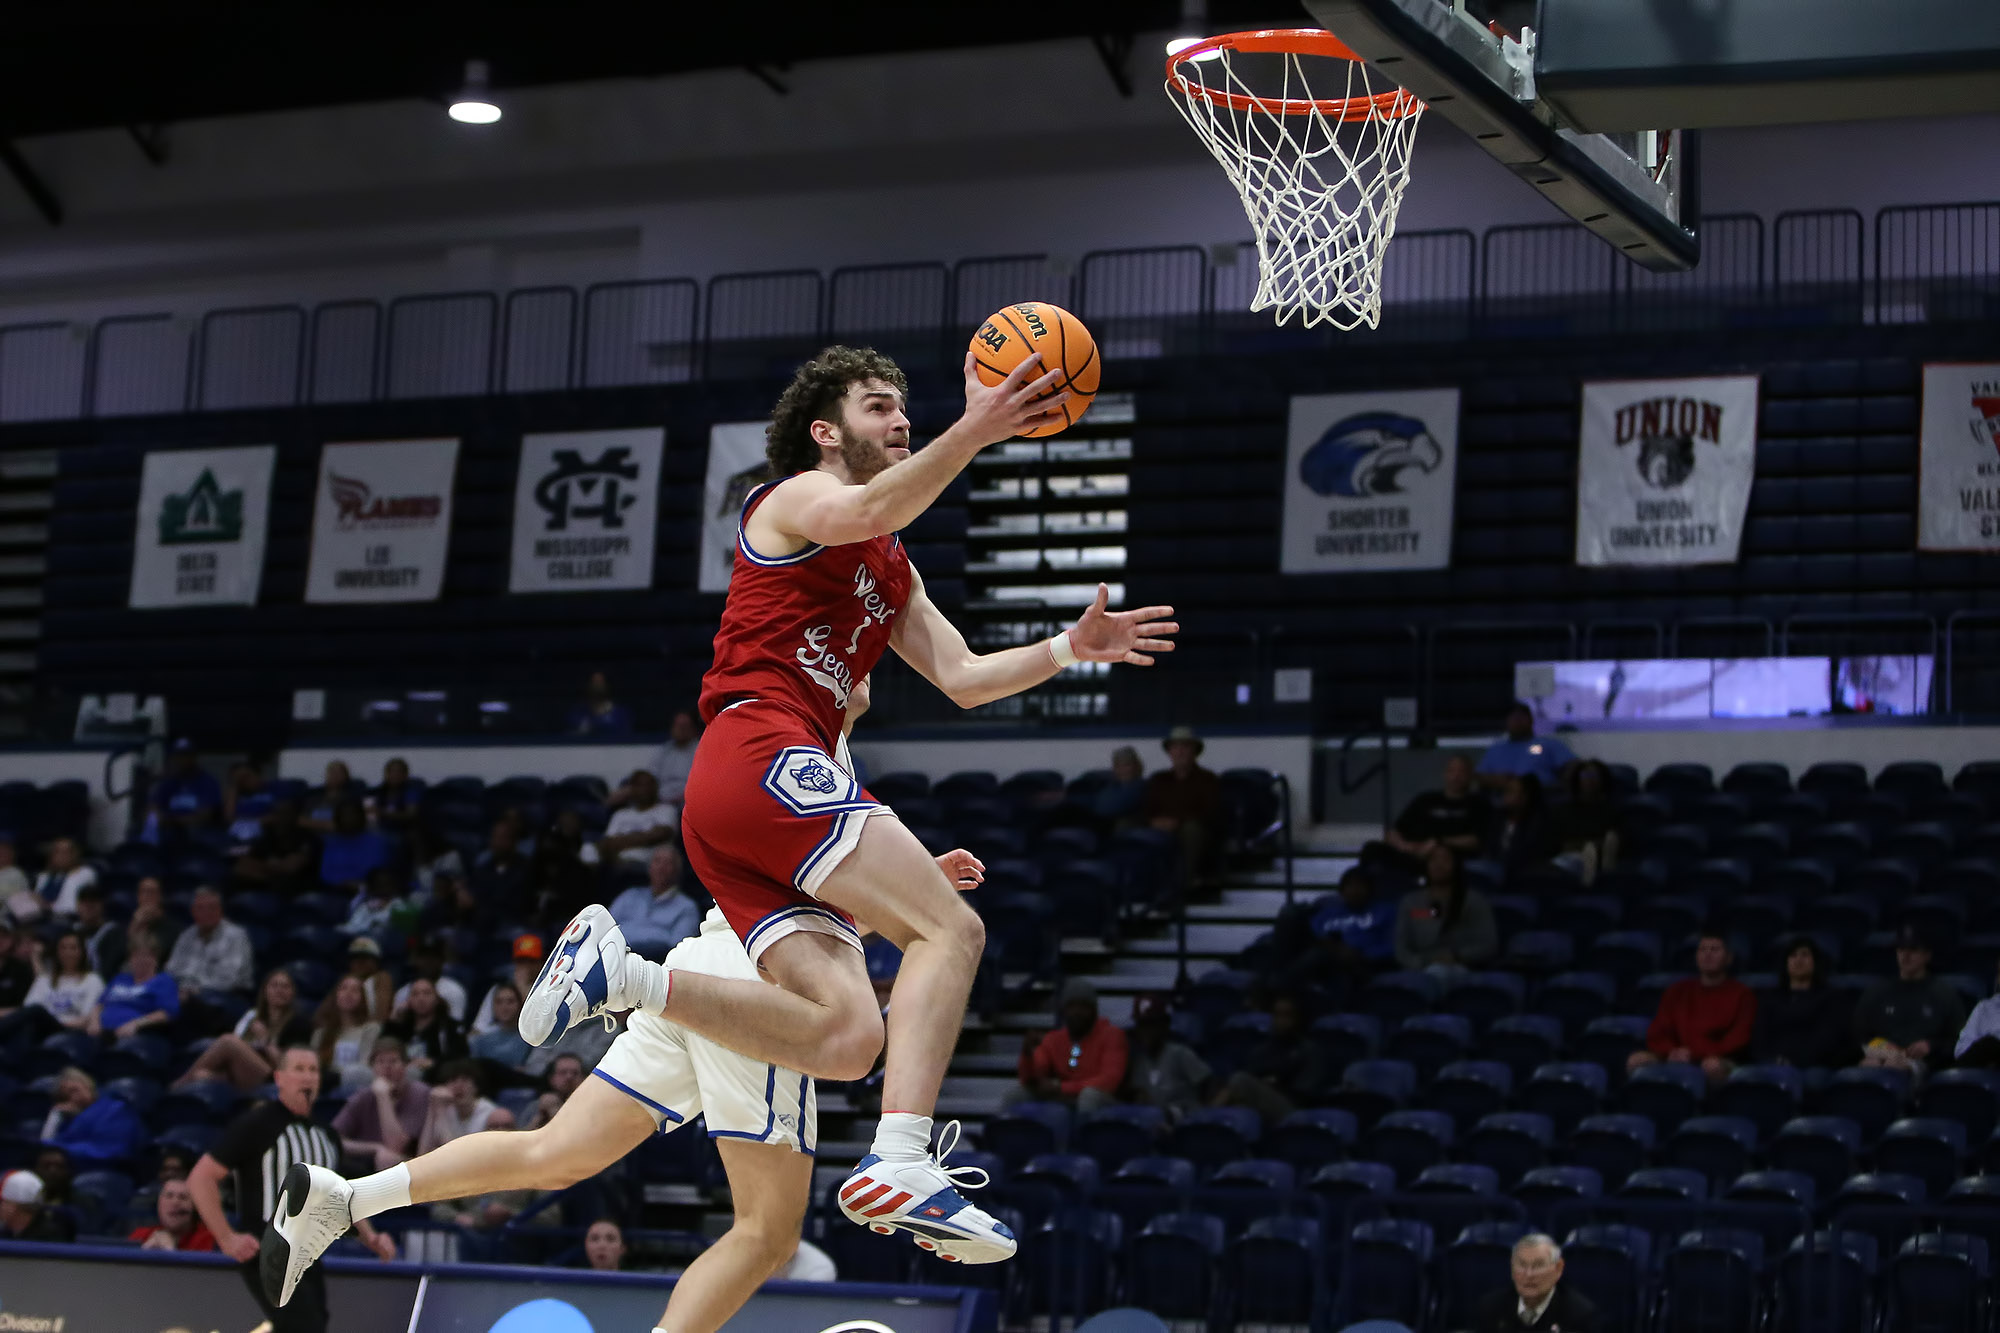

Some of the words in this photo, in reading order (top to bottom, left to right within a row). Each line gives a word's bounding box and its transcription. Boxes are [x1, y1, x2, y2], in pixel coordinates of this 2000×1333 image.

[975, 320, 1009, 353] CAA
[1614, 396, 1723, 447] UNION
[1328, 506, 1410, 531] SHORTER
[1636, 499, 1693, 522] UNION
[534, 537, 630, 559] MISSISSIPPI
[1315, 531, 1420, 556] UNIVERSITY
[1610, 523, 1717, 549] UNIVERSITY
[334, 567, 420, 589] UNIVERSITY
[547, 558, 614, 580] COLLEGE
